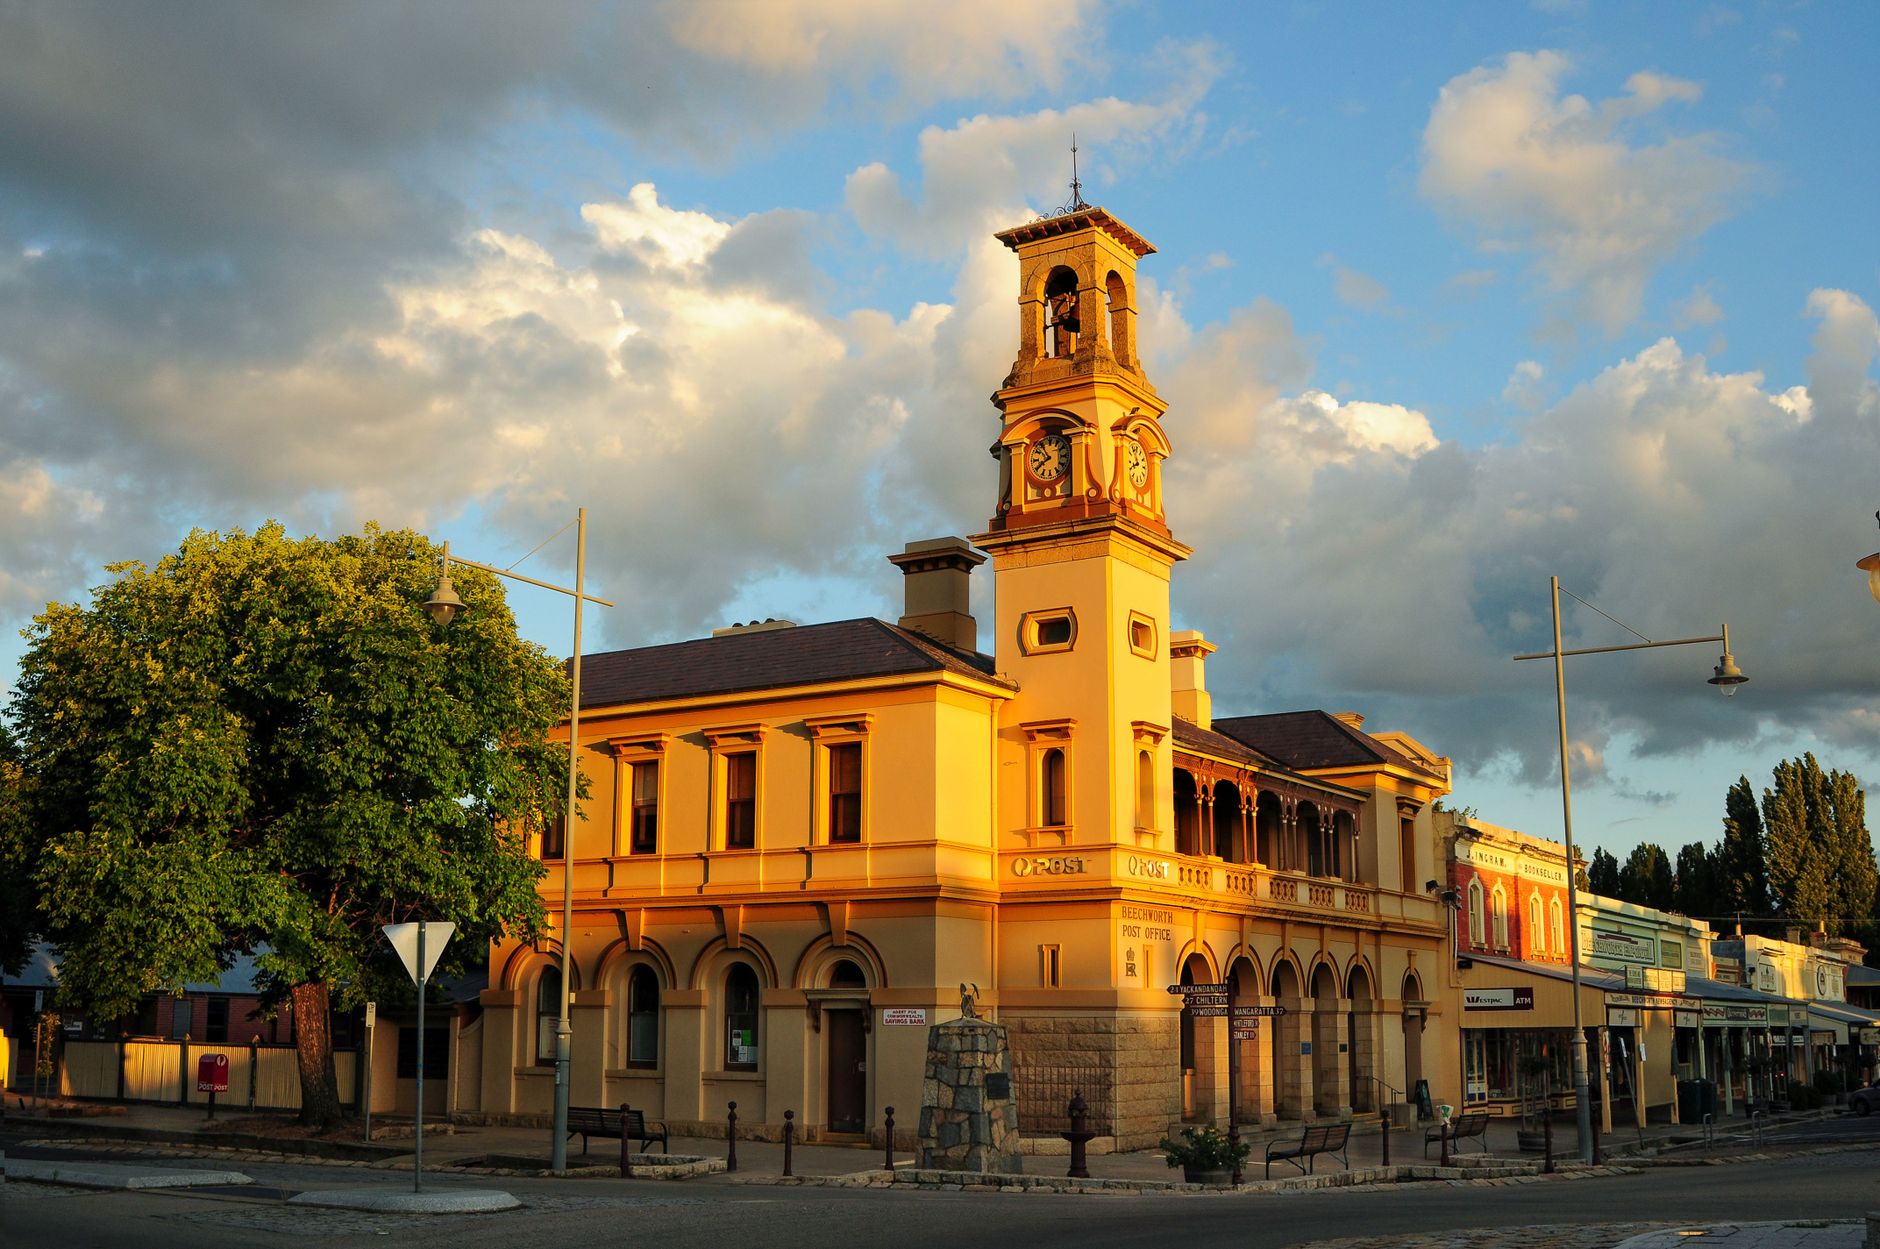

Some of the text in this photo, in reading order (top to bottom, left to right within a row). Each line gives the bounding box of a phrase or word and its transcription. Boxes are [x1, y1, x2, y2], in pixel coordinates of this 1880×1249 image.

[1032, 856, 1089, 876] POST
[1139, 858, 1171, 879] POST
[1121, 905, 1174, 924] BEECHWORTH
[1122, 924, 1172, 941] POST OFFICE
[1180, 984, 1228, 994] YACKANDANDAH
[1185, 996, 1228, 1005] 27 CHILTERN
[1515, 997, 1531, 1005] ATM
[1199, 1007, 1228, 1016] WODONGA
[1234, 1007, 1275, 1016] WANGARATTA
